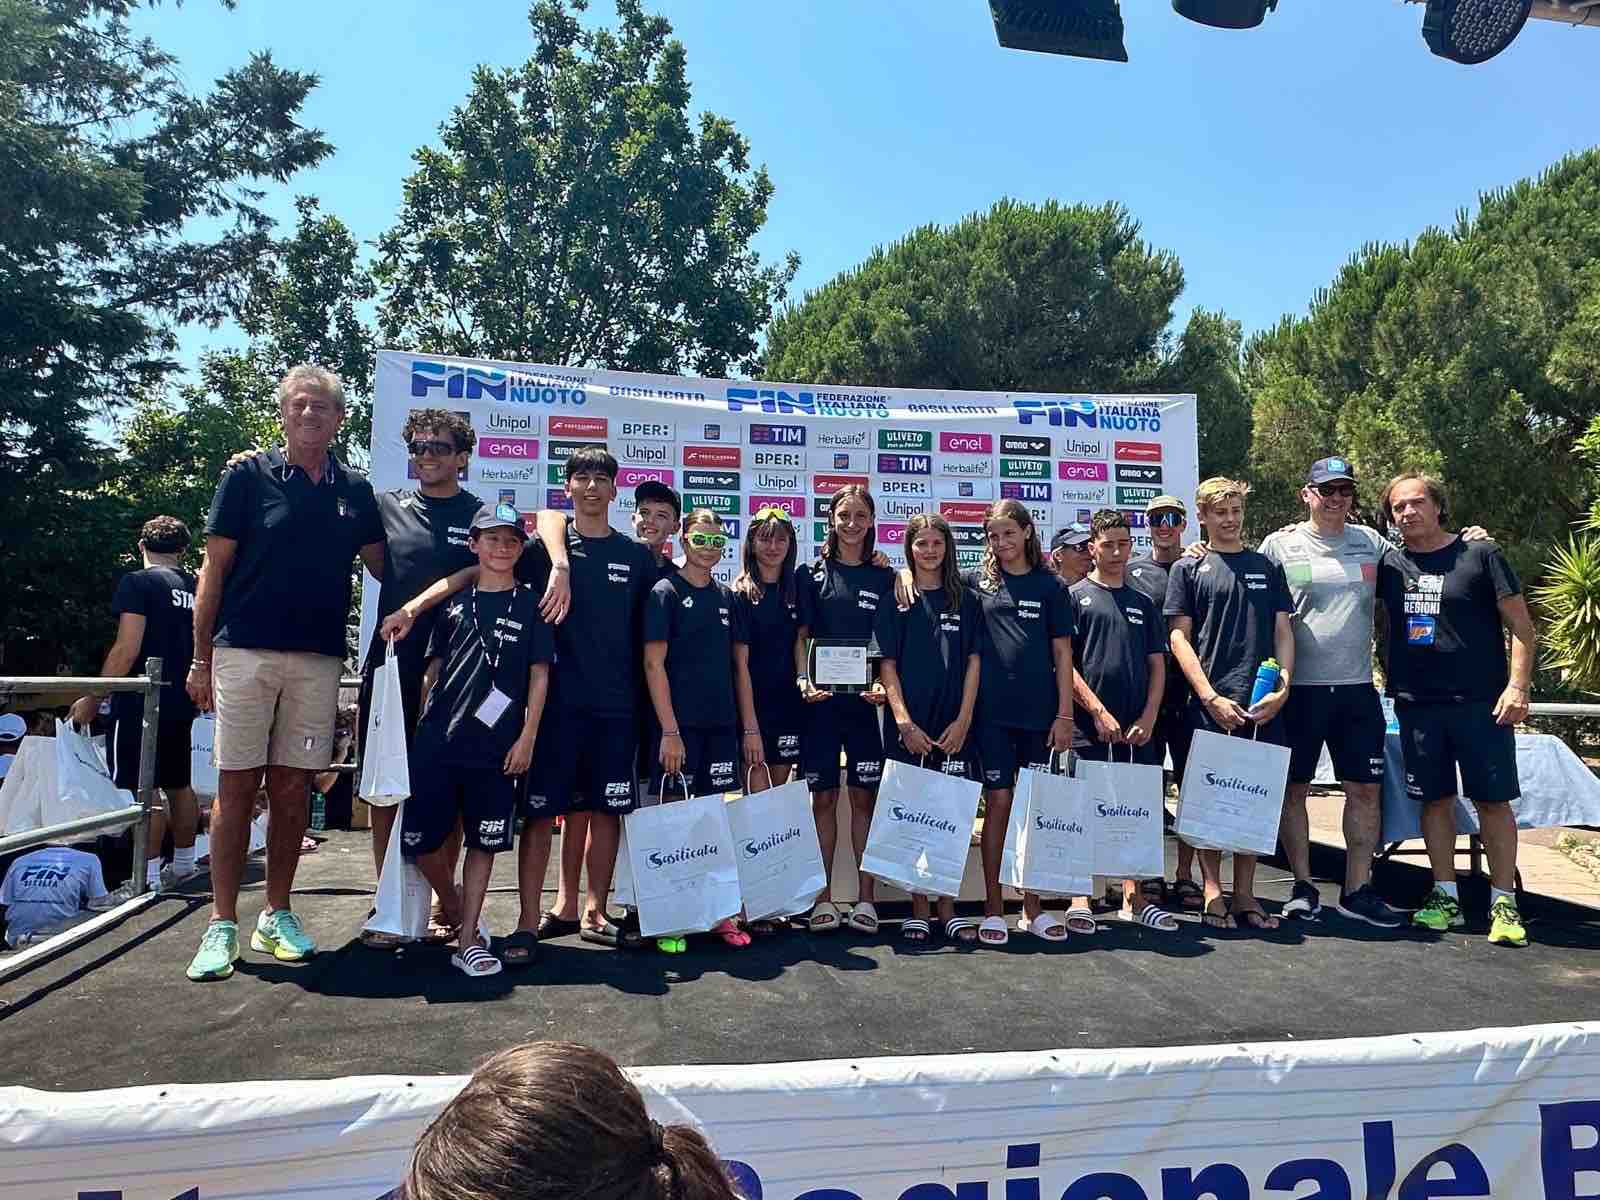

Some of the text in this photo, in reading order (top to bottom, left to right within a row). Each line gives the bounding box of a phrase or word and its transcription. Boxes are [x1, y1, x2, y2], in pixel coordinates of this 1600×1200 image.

[411, 361, 507, 400] FIN
[510, 387, 587, 404] NUOTO
[726, 388, 816, 415] FIN
[816, 392, 887, 404] FEDERAZIONE
[816, 401, 888, 411] ITALIANA
[819, 407, 890, 419] NUOTO
[1100, 405, 1161, 418] ITALIANA
[1013, 400, 1097, 429] FIN
[489, 412, 531, 432] Unipol
[1100, 415, 1161, 432] NUOTO
[622, 423, 669, 436] BPER:
[772, 427, 802, 442] TIM
[817, 432, 863, 445] Herbalife
[886, 431, 923, 443] ULIVETO
[949, 436, 982, 450] enel
[489, 443, 528, 457] enel
[1005, 441, 1028, 450] arena
[1065, 438, 1101, 456] Unipol
[626, 443, 667, 463] Unipol
[754, 452, 800, 465] BPER:
[899, 457, 928, 472] TIM
[943, 463, 986, 475] Herbalife
[1008, 460, 1042, 471] ULIVETO
[1067, 465, 1100, 478] enel
[481, 468, 531, 483] Herbalife
[689, 475, 715, 485] arena
[1119, 469, 1142, 478] arena
[757, 473, 797, 491] Unipol
[882, 481, 925, 493] BPER:
[1021, 485, 1048, 499] TIM
[1123, 488, 1156, 498] ULIVETO
[691, 495, 731, 507] ULIVETO
[886, 501, 924, 519] Unipol
[1403, 601, 1441, 615] REGIONI
[709, 761, 734, 775] FIN
[605, 781, 631, 796] FIN
[479, 818, 505, 834] FIN
[21, 864, 71, 881] FIN
